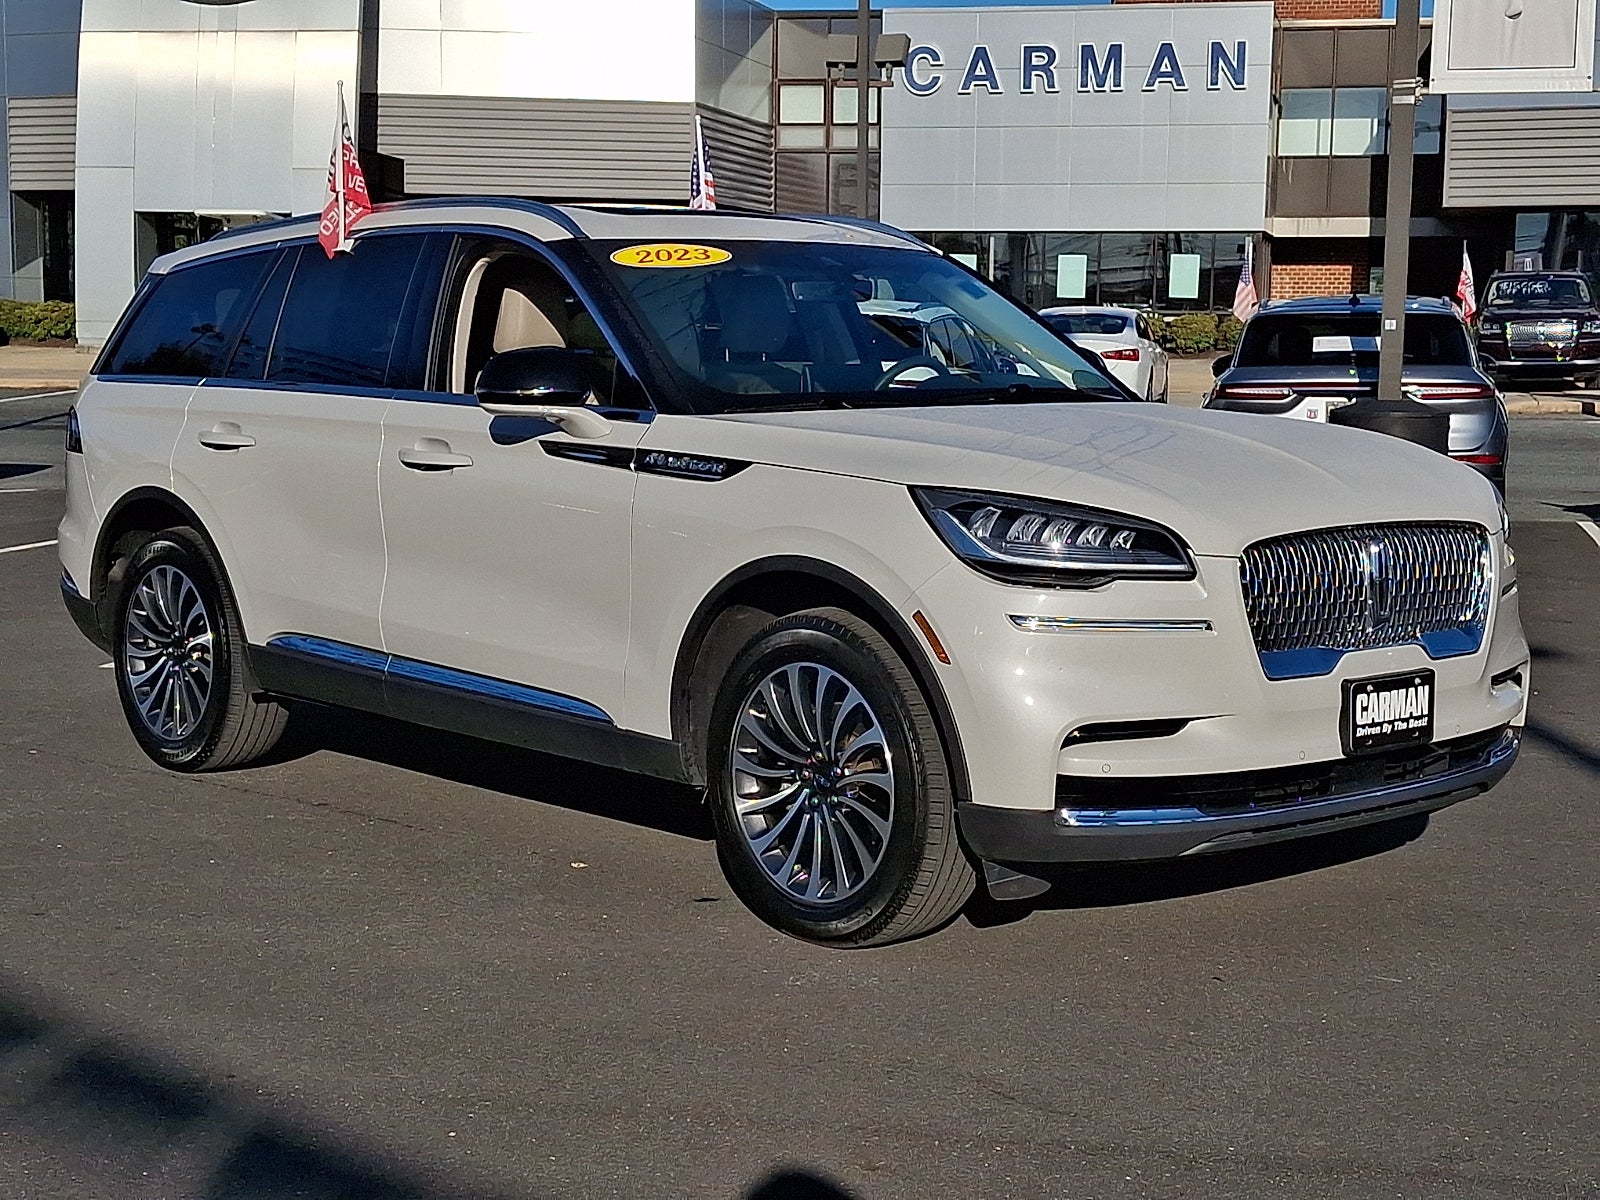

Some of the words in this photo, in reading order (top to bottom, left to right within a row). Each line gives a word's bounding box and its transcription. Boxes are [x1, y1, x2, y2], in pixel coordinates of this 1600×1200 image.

[902, 40, 1248, 96] CARMAN
[635, 248, 711, 264] 2023
[1355, 685, 1430, 726] CARMAN
[1355, 725, 1381, 738] Driven
[1382, 722, 1393, 734] By
[1394, 720, 1408, 731] The
